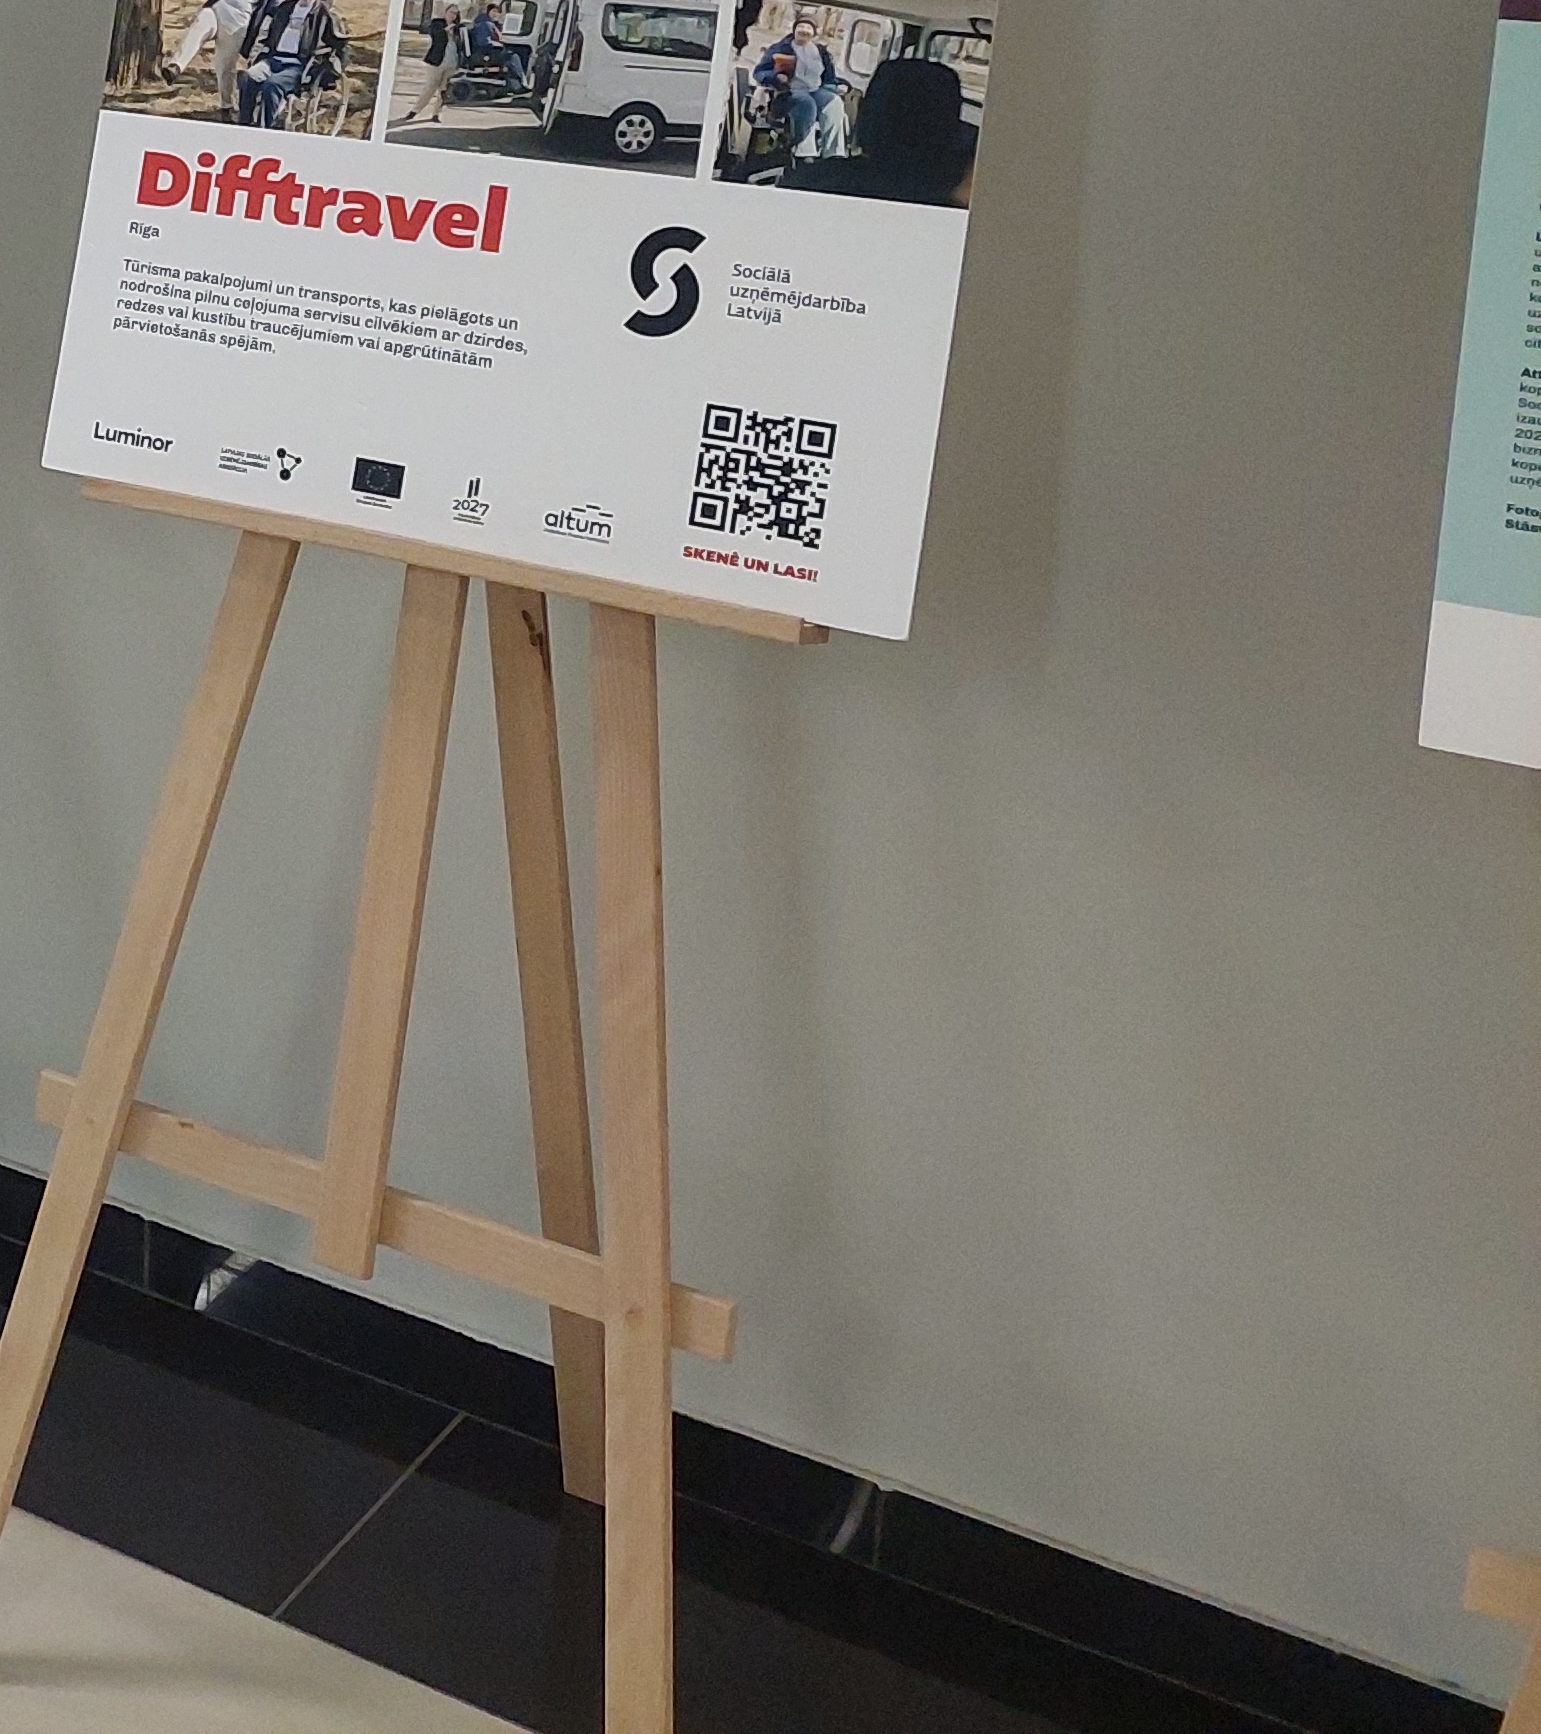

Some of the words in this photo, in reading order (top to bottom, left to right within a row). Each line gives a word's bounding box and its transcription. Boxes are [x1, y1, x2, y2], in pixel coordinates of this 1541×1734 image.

[136, 150, 508, 253] Difftravel
[129, 222, 161, 240] Rīga
[731, 262, 791, 284] Sociālā
[122, 258, 181, 279] Tūrisma
[183, 269, 273, 293] pakalpojumi
[275, 283, 295, 296] un
[297, 284, 384, 312] transports,
[388, 297, 417, 315] kas
[419, 304, 494, 326] pielāgots
[497, 317, 518, 330] un
[729, 283, 866, 314] uzņēmējdarbība
[119, 279, 191, 300] nodrošina
[193, 289, 230, 306] pilnu
[232, 296, 300, 318] ceļojuma
[303, 308, 361, 327] servisu
[363, 314, 437, 339] cilvēkiem
[440, 329, 461, 342] ar
[463, 330, 528, 355] dzirdes,
[726, 302, 781, 326] Latvijā
[112, 315, 216, 343] pārvietošanās
[218, 334, 275, 354] spējām.
[116, 297, 165, 315] redzes
[167, 305, 189, 319] vai
[191, 306, 246, 328] kustību
[249, 316, 354, 346] traucējumiem
[356, 336, 381, 350] vai
[383, 340, 493, 368] apgrūtinātām
[94, 421, 173, 452] Luminor
[452, 499, 490, 516] 2027
[1506, 502, 1541, 520] Foto
[544, 510, 613, 538] altum
[1505, 518, 1541, 533] Stās
[682, 545, 740, 567] SKENĒ
[742, 556, 769, 573] UN
[772, 562, 818, 582] LASI!
